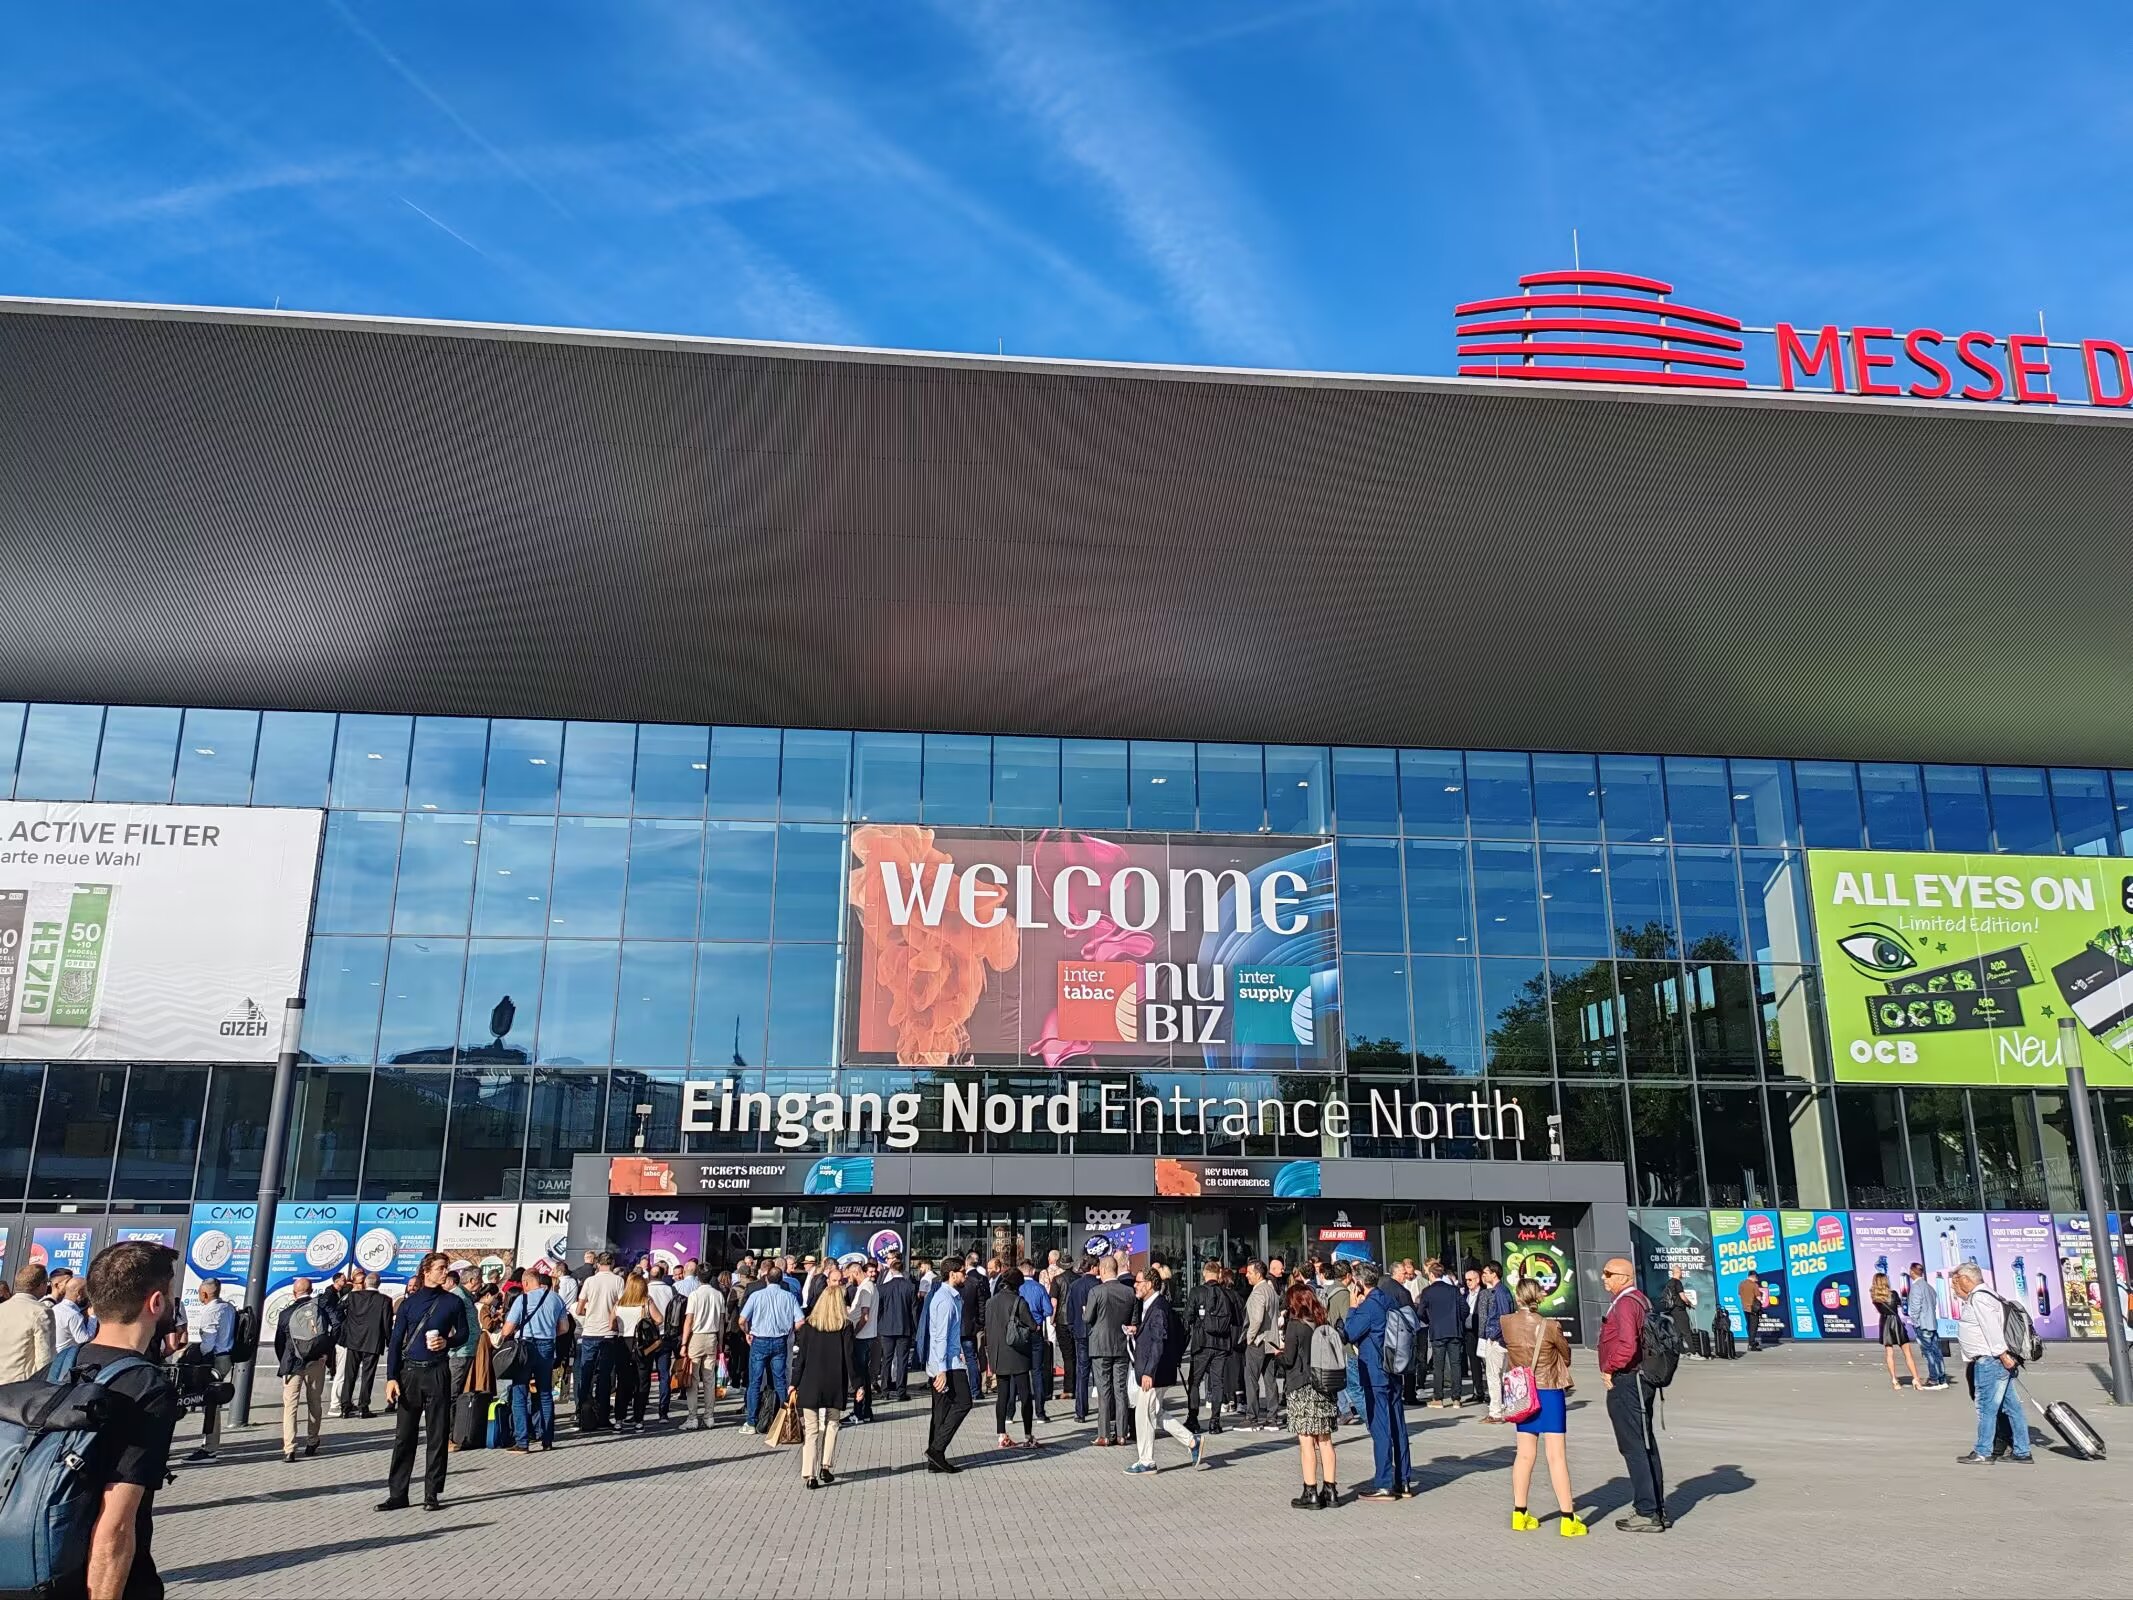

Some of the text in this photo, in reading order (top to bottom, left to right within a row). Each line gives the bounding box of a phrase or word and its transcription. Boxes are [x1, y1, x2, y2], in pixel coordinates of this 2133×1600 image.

[1775, 322, 2060, 405] MESSE
[8, 820, 220, 847] ACTIVE FILTER
[43, 854, 90, 866] neue
[95, 851, 141, 867] Wahl
[1832, 871, 1911, 907] ALL
[1914, 873, 2025, 911] EYES
[2030, 876, 2096, 911] ON
[1898, 914, 2040, 934] Limited Edition!
[0, 929, 18, 948] 0
[71, 923, 101, 942] 50
[1063, 966, 1106, 983] inter
[1238, 970, 1276, 986] inter
[1063, 984, 1116, 1001] tabac
[1238, 986, 1295, 1004] supply
[1879, 999, 1957, 1029] OCB
[219, 1021, 268, 1037] GIZEH
[1145, 1004, 1226, 1044] BIZ
[1849, 1039, 1919, 1065] OCB
[681, 1080, 1526, 1150] Eingang Nord Entrance North
[701, 1165, 786, 1176] TICKETS READY
[1205, 1167, 1249, 1176] KEY BUYER
[700, 1179, 716, 1189] TO
[1205, 1178, 1271, 1187] CB CONFERENCE
[211, 1206, 255, 1220] CAMO
[294, 1206, 337, 1220] CAMO
[376, 1206, 419, 1220] CAMO
[834, 1205, 905, 1218] TASTE THE LEGEND
[1518, 1212, 1552, 1230] bagz
[64, 1232, 87, 1241] FEELS
[1321, 1231, 1363, 1239] FEAR NOTHING
[69, 1241, 86, 1249] LIKE
[274, 1240, 282, 1249] 7
[399, 1240, 406, 1249] 7
[1655, 1246, 1689, 1254] WELCOME
[1719, 1235, 1776, 1258] PRAGUE
[1789, 1236, 1846, 1260] PRAGUE
[54, 1249, 84, 1258] EXITING
[1650, 1254, 1706, 1263] CB CONFERENCE
[68, 1258, 84, 1266] THE
[1720, 1255, 1758, 1276] 2026
[1791, 1256, 1828, 1276] 2026
[1668, 1270, 1691, 1278] SGE
[176, 1394, 204, 1407] RONIN
